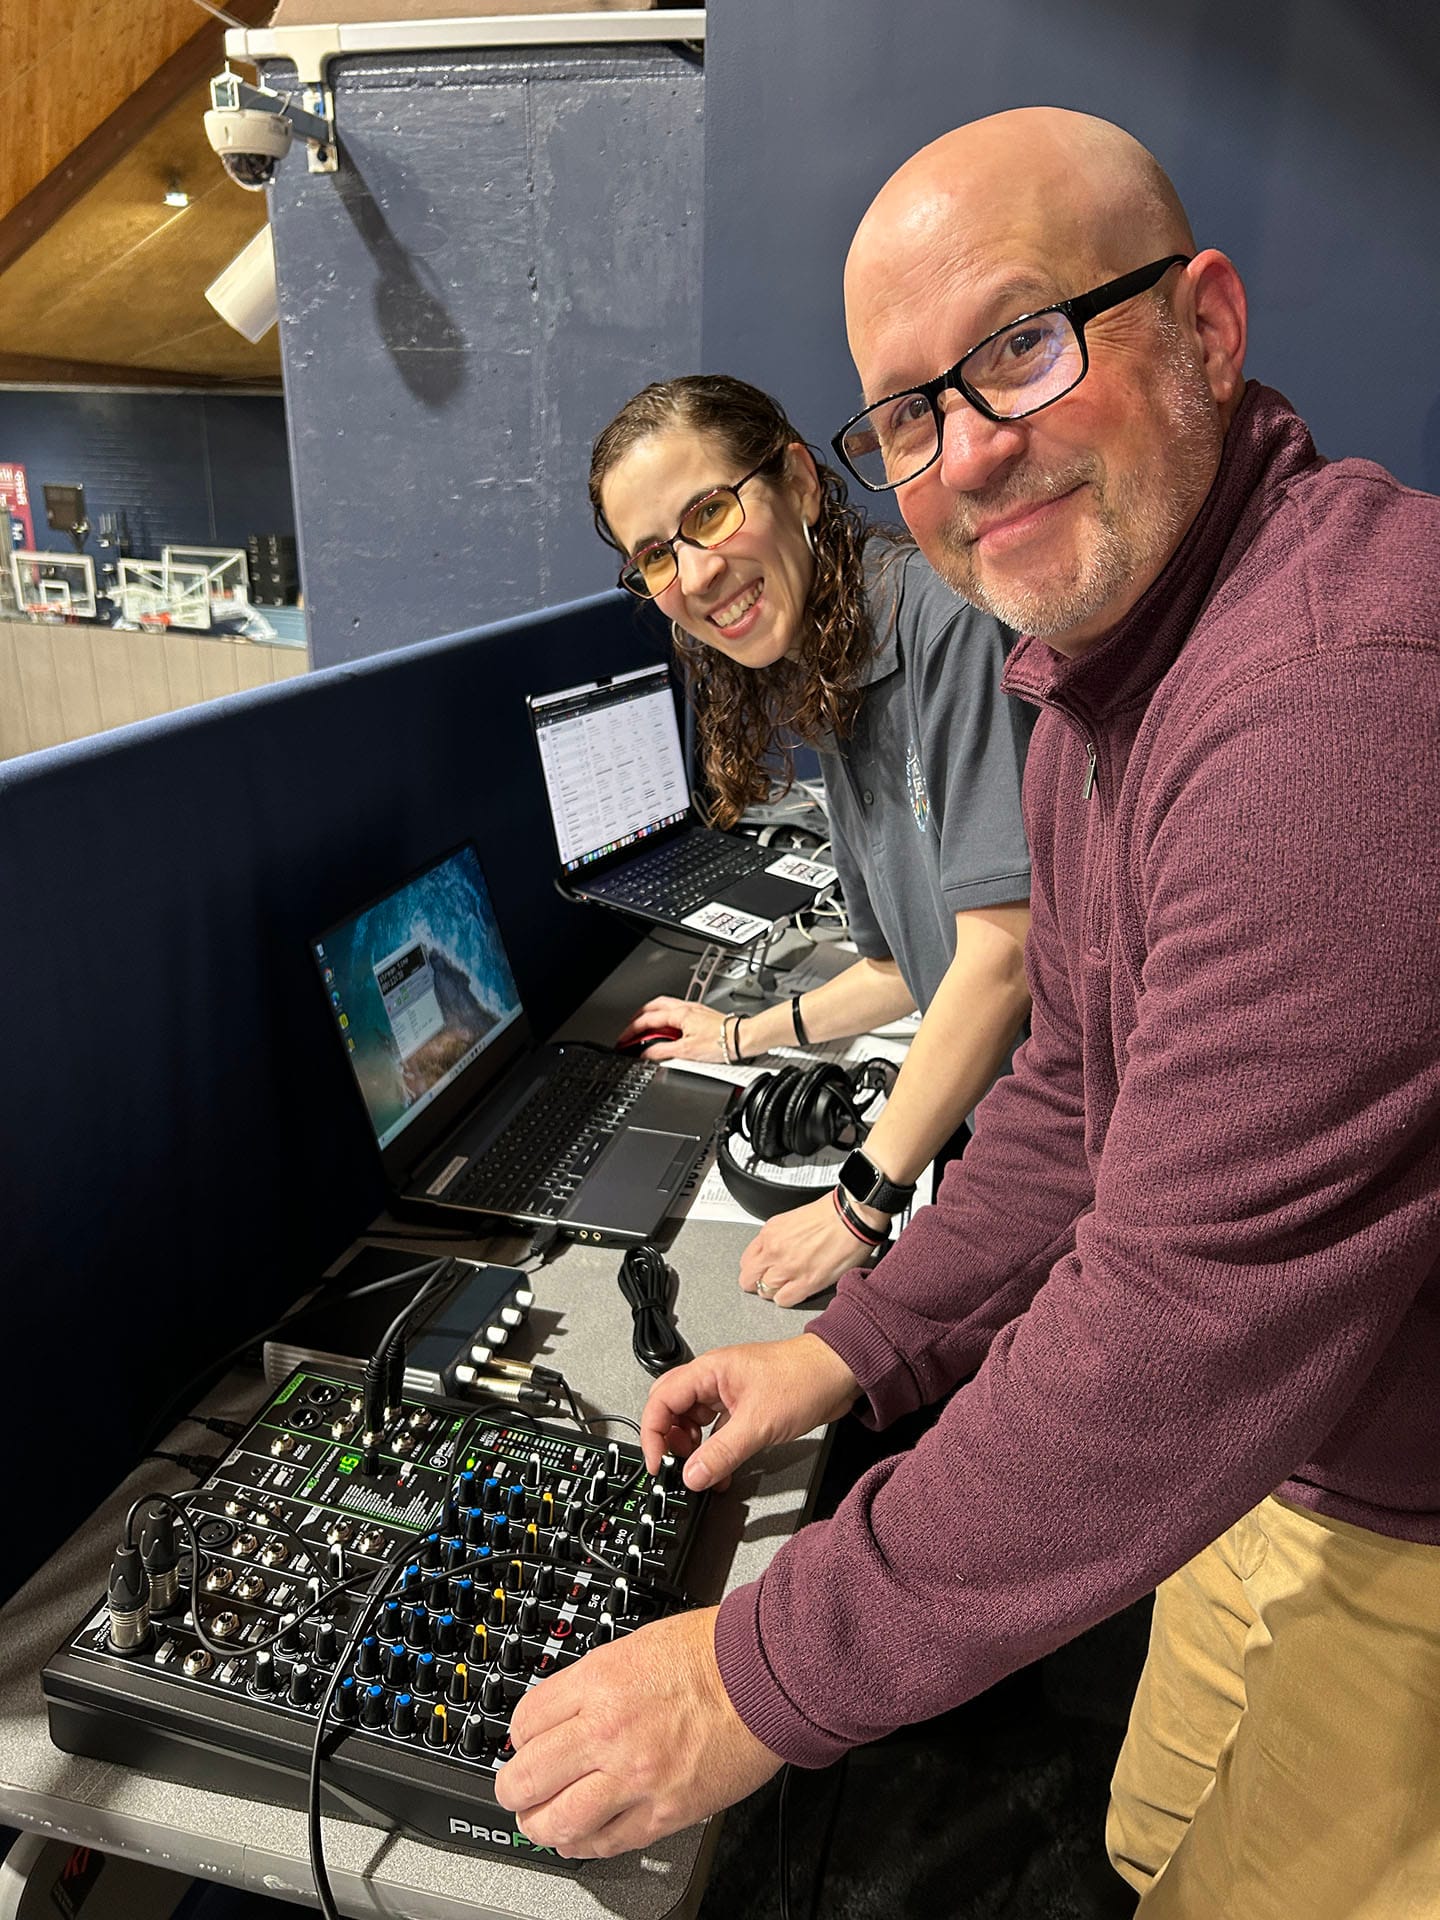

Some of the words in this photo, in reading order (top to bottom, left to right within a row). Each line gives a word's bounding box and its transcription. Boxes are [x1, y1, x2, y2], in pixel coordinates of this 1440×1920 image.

[623, 1500, 637, 1511] FX
[615, 1529, 628, 1545] 9/10
[588, 1593, 600, 1608] 5/6
[576, 1631, 585, 1641] 4
